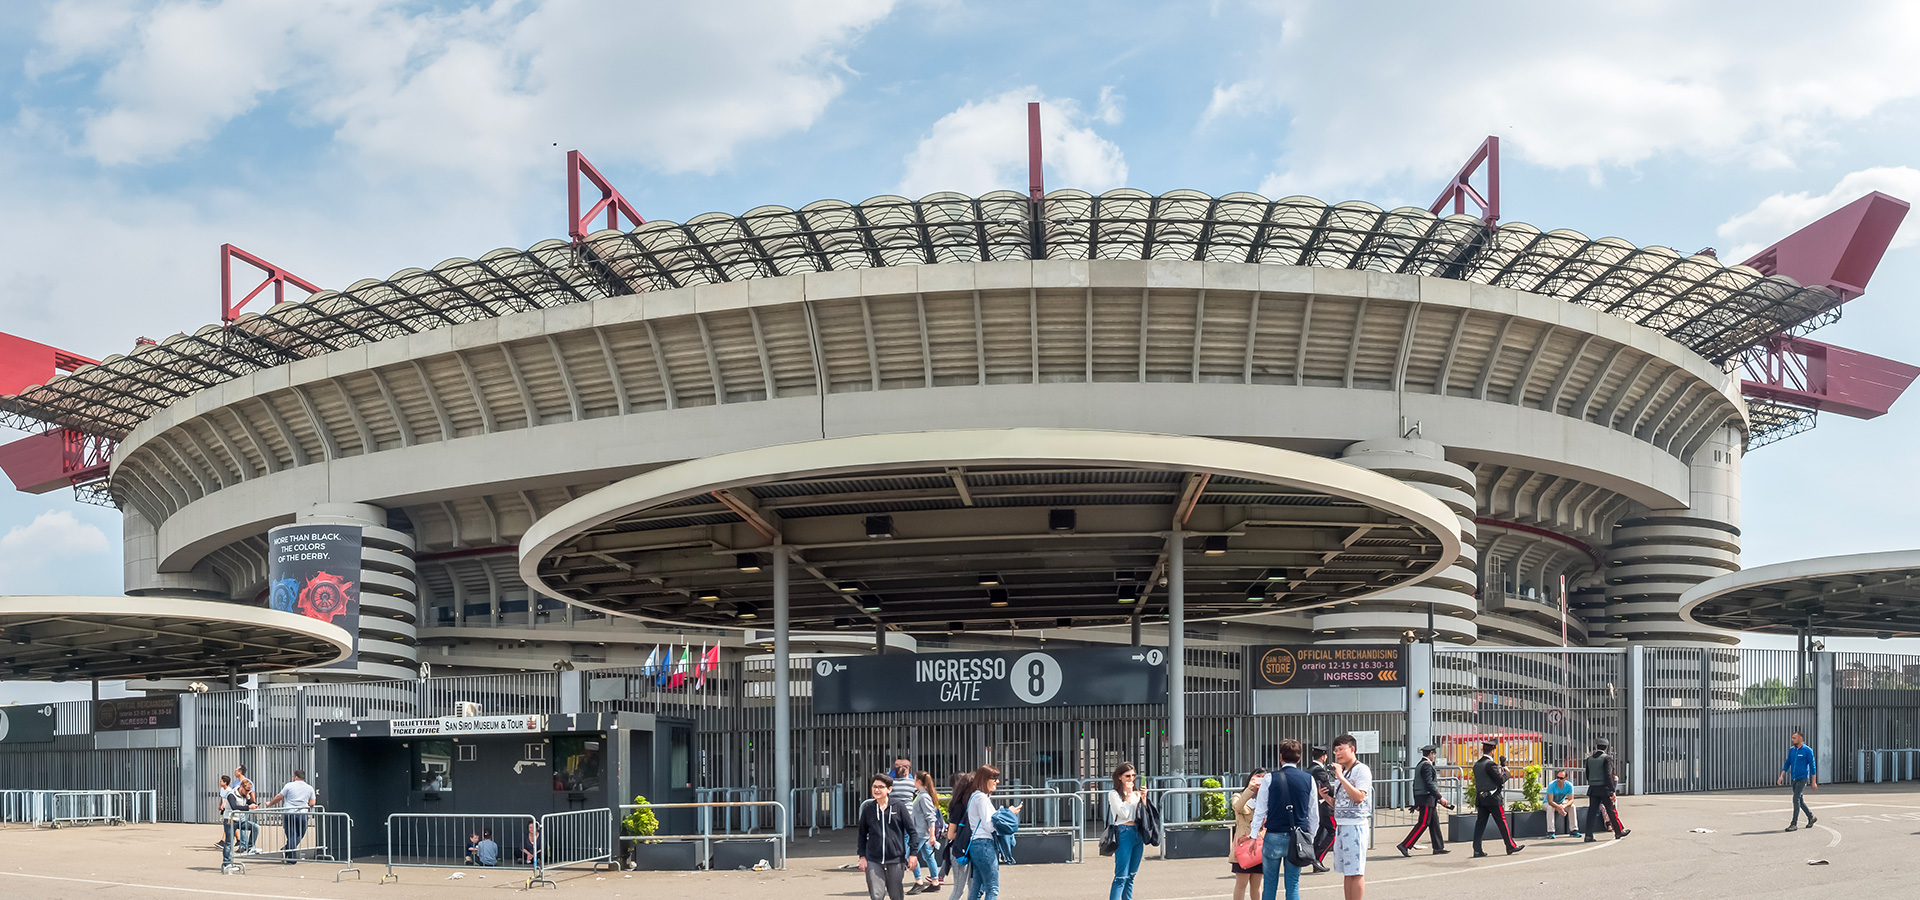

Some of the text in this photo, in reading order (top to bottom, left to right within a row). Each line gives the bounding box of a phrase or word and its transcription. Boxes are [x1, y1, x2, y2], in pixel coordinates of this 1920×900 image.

[274, 533, 341, 545] MORE THAN BLACK.
[281, 543, 326, 553] THE COLORS
[278, 552, 331, 563] OF THE DERBY.
[1278, 655, 1291, 663] SIRO
[1298, 649, 1398, 660] OFFICIAL MERCHANDISING
[1266, 663, 1291, 674] STORE
[1302, 662, 1326, 670] orario
[1360, 661, 1394, 669] 16.30-18
[916, 657, 1045, 697] INGRESSO 8
[1323, 672, 1374, 681] INGRESSO
[940, 681, 982, 702] GATE
[445, 719, 524, 731] SAN SIRO MUSEUM & TOUR
